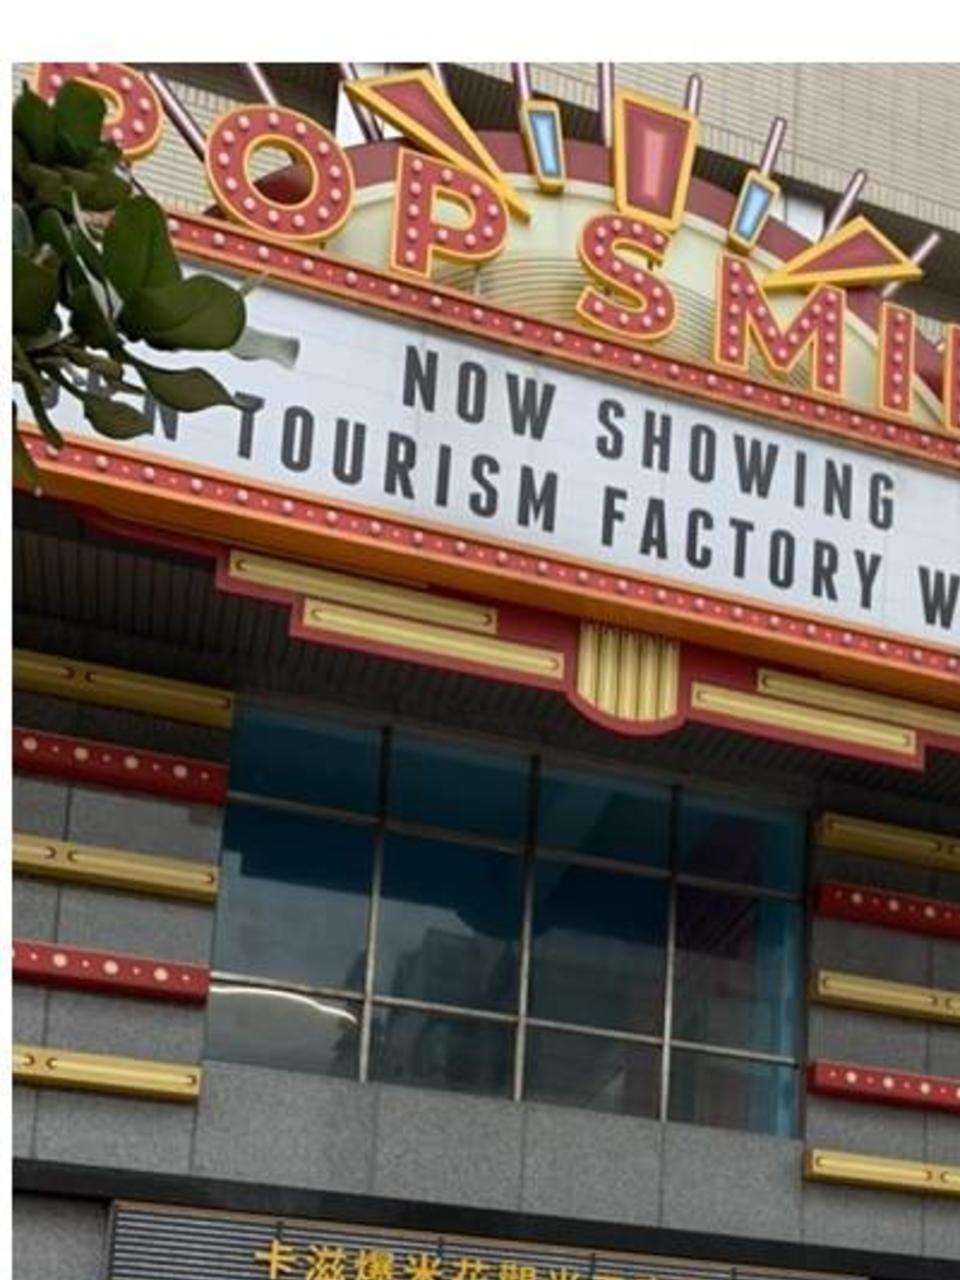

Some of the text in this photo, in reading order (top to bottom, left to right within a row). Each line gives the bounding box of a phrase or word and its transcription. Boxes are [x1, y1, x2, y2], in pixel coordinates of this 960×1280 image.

[235, 392, 559, 535] TOURISM
[600, 486, 882, 611] FACTORY
[402, 344, 896, 532] NOW SHOWING
